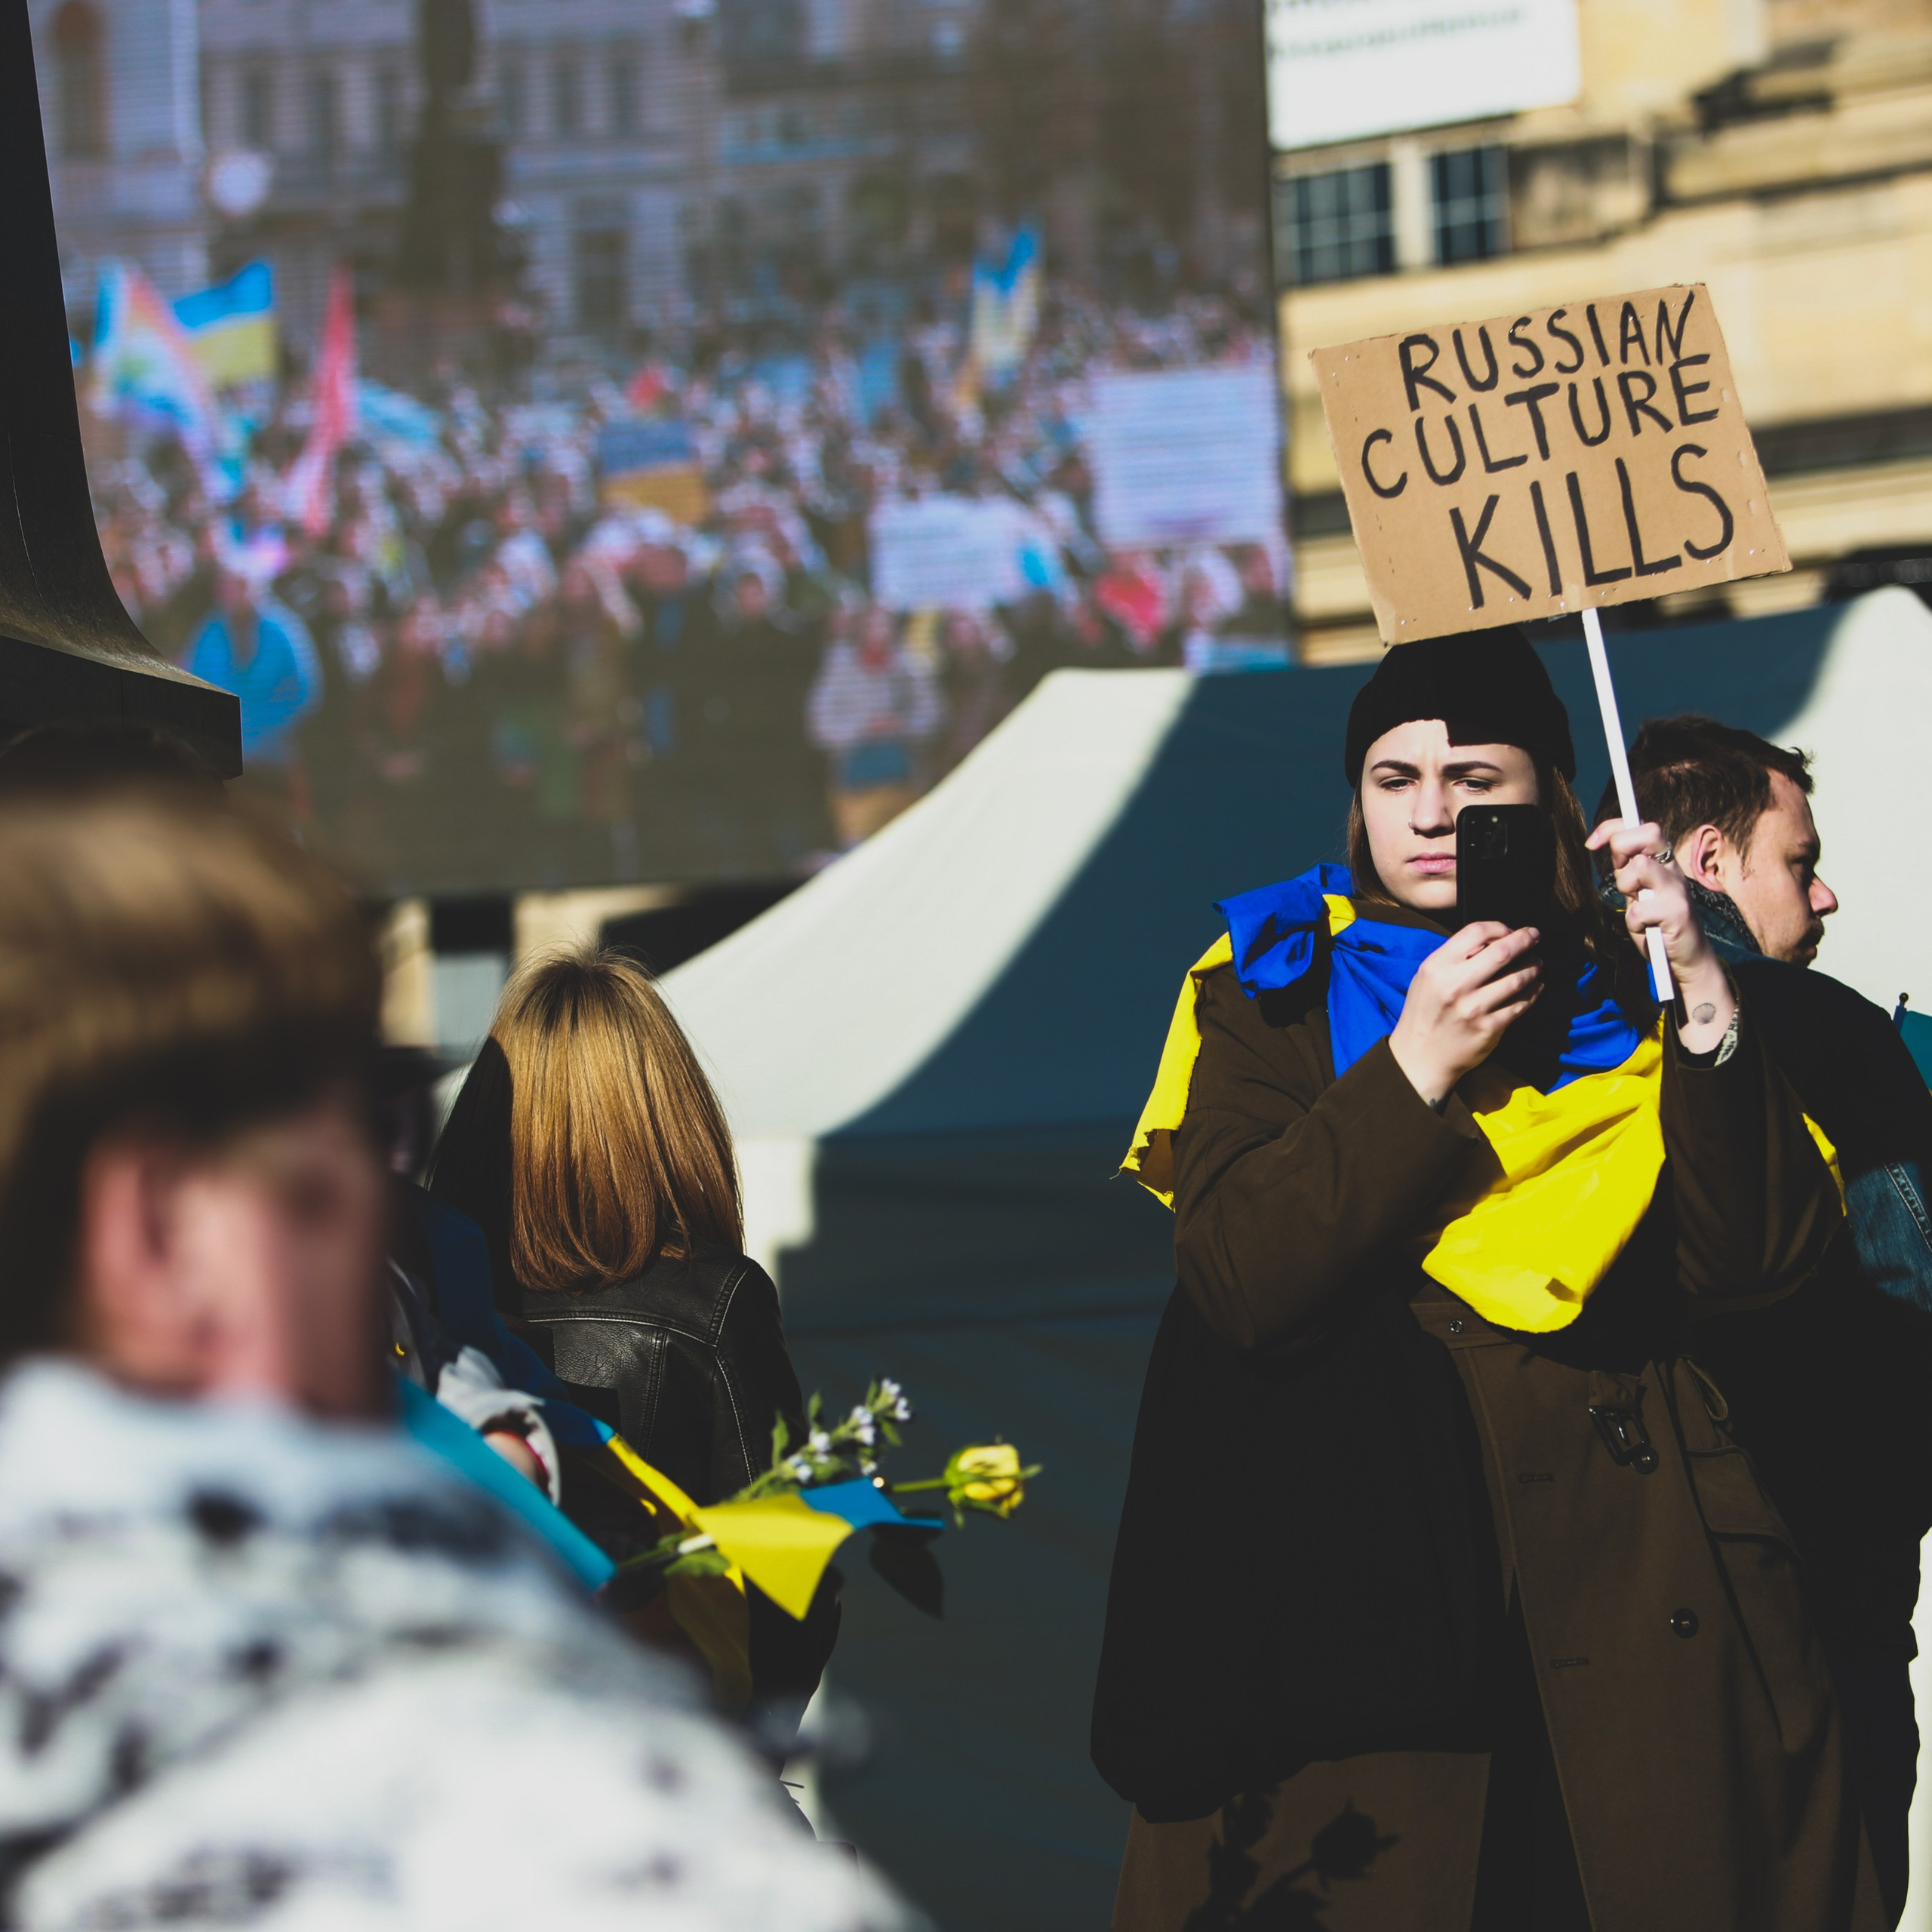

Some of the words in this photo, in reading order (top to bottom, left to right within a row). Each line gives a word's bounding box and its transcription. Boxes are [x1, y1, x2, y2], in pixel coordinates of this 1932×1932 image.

[1398, 291, 1695, 411] RUSSIAN
[1361, 353, 1719, 498] CULTURE
[1449, 444, 1734, 608] KILLS
